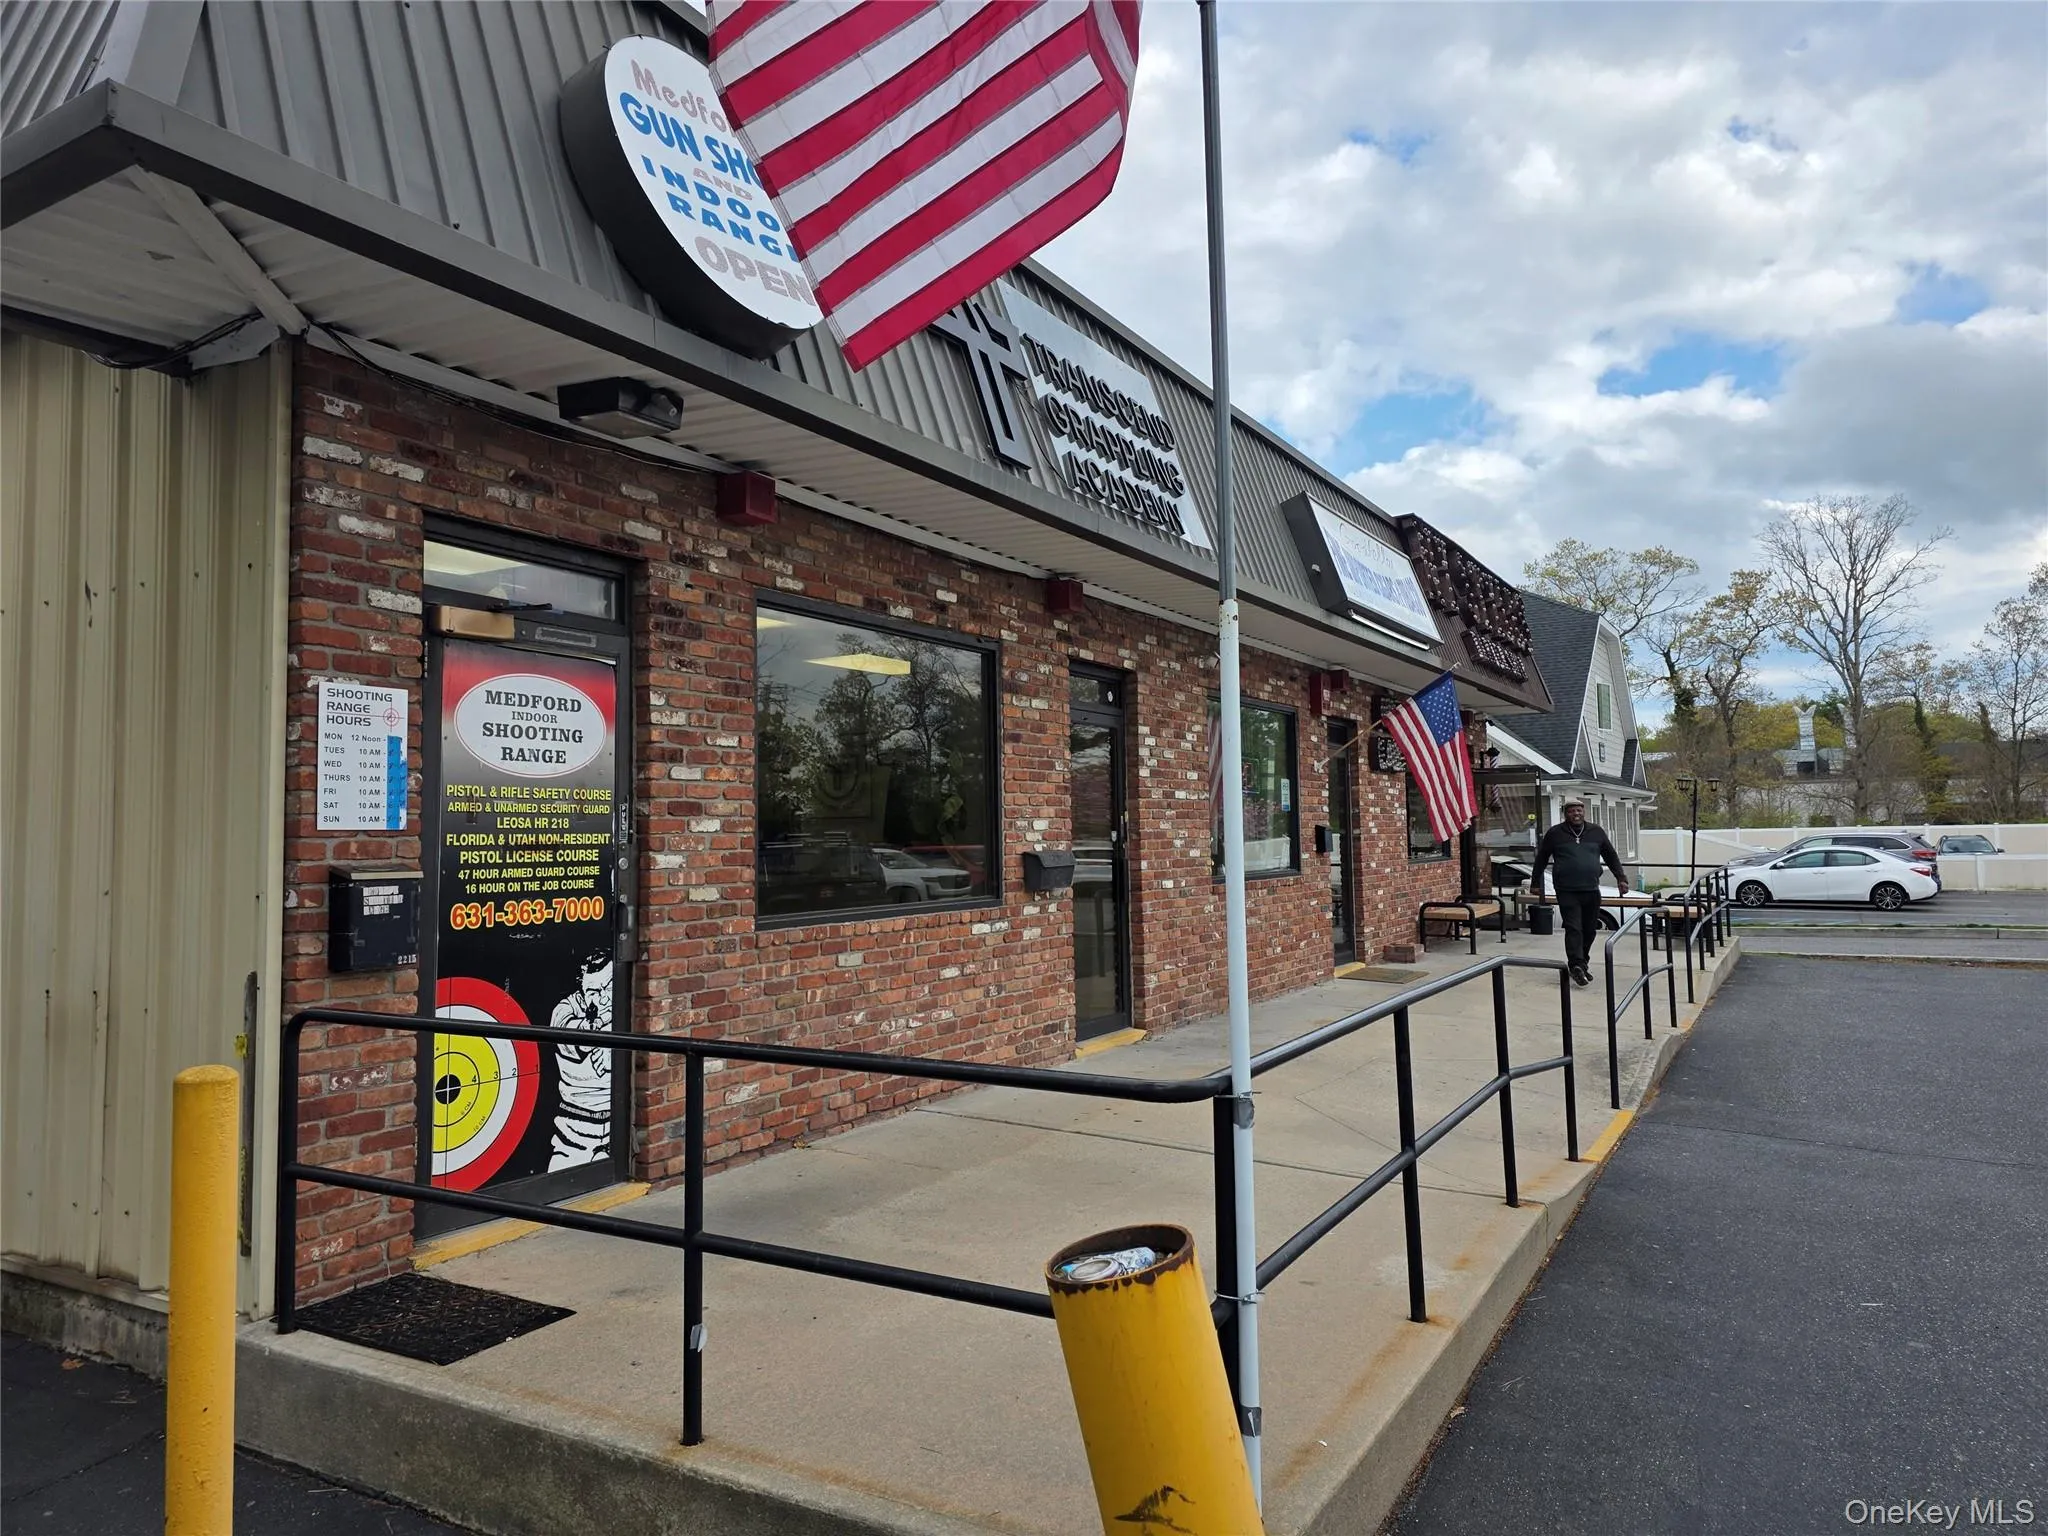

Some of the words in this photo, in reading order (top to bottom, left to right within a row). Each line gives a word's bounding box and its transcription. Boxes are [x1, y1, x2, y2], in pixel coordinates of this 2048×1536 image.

[631, 60, 735, 137] Medfo
[620, 92, 702, 162] GUN
[693, 167, 752, 201] AND
[694, 236, 816, 306] OPEN
[1020, 333, 1175, 452] TRANSCEND
[1039, 393, 1186, 498] GRAPPLING
[1062, 450, 1186, 536] ACADEMY
[327, 688, 392, 702] SHOOTING
[485, 690, 582, 712] MEDFORD
[327, 702, 371, 713] RANGE
[326, 714, 371, 727] HOURS
[512, 711, 557, 723] INDOOR
[324, 732, 342, 740] MON
[482, 722, 583, 743] SHOOTING
[501, 747, 566, 763] RANGE
[324, 774, 350, 782] THURS
[446, 785, 486, 797] PISTOL
[489, 786, 497, 797] &
[501, 787, 530, 798] RIFLE
[533, 788, 570, 800] SAFETY
[573, 789, 611, 800] COURSE
[448, 802, 482, 812] ARMED
[485, 802, 491, 812] &
[494, 803, 537, 813] UNARMED
[540, 803, 580, 813] SECURITY
[583, 804, 609, 814] GUARD
[497, 817, 531, 828] LEOSA
[535, 818, 548, 828] HR
[551, 818, 569, 828] 218
[447, 834, 495, 845] FLORIDA
[498, 834, 505, 845] &
[509, 834, 535, 845] UTAH
[539, 833, 610, 845] NON-RESIDENT
[460, 851, 502, 864] PISTOL
[506, 850, 553, 863] LICENSE
[556, 849, 599, 862] COURSE
[458, 869, 470, 880] 47
[473, 868, 499, 879] HOUR
[501, 867, 533, 878] ARMED
[536, 866, 565, 877] GUARD
[567, 865, 600, 876] COURSE
[465, 884, 476, 894] 16
[479, 882, 505, 893] HOUR
[508, 881, 520, 892] ON
[523, 880, 540, 891] THE
[542, 880, 558, 890] JOB
[561, 879, 594, 890] COURSE
[450, 896, 604, 930] 631-363-7000
[397, 954, 417, 965] 2215
[493, 1071, 499, 1080] 3
[511, 1067, 517, 1076] 2
